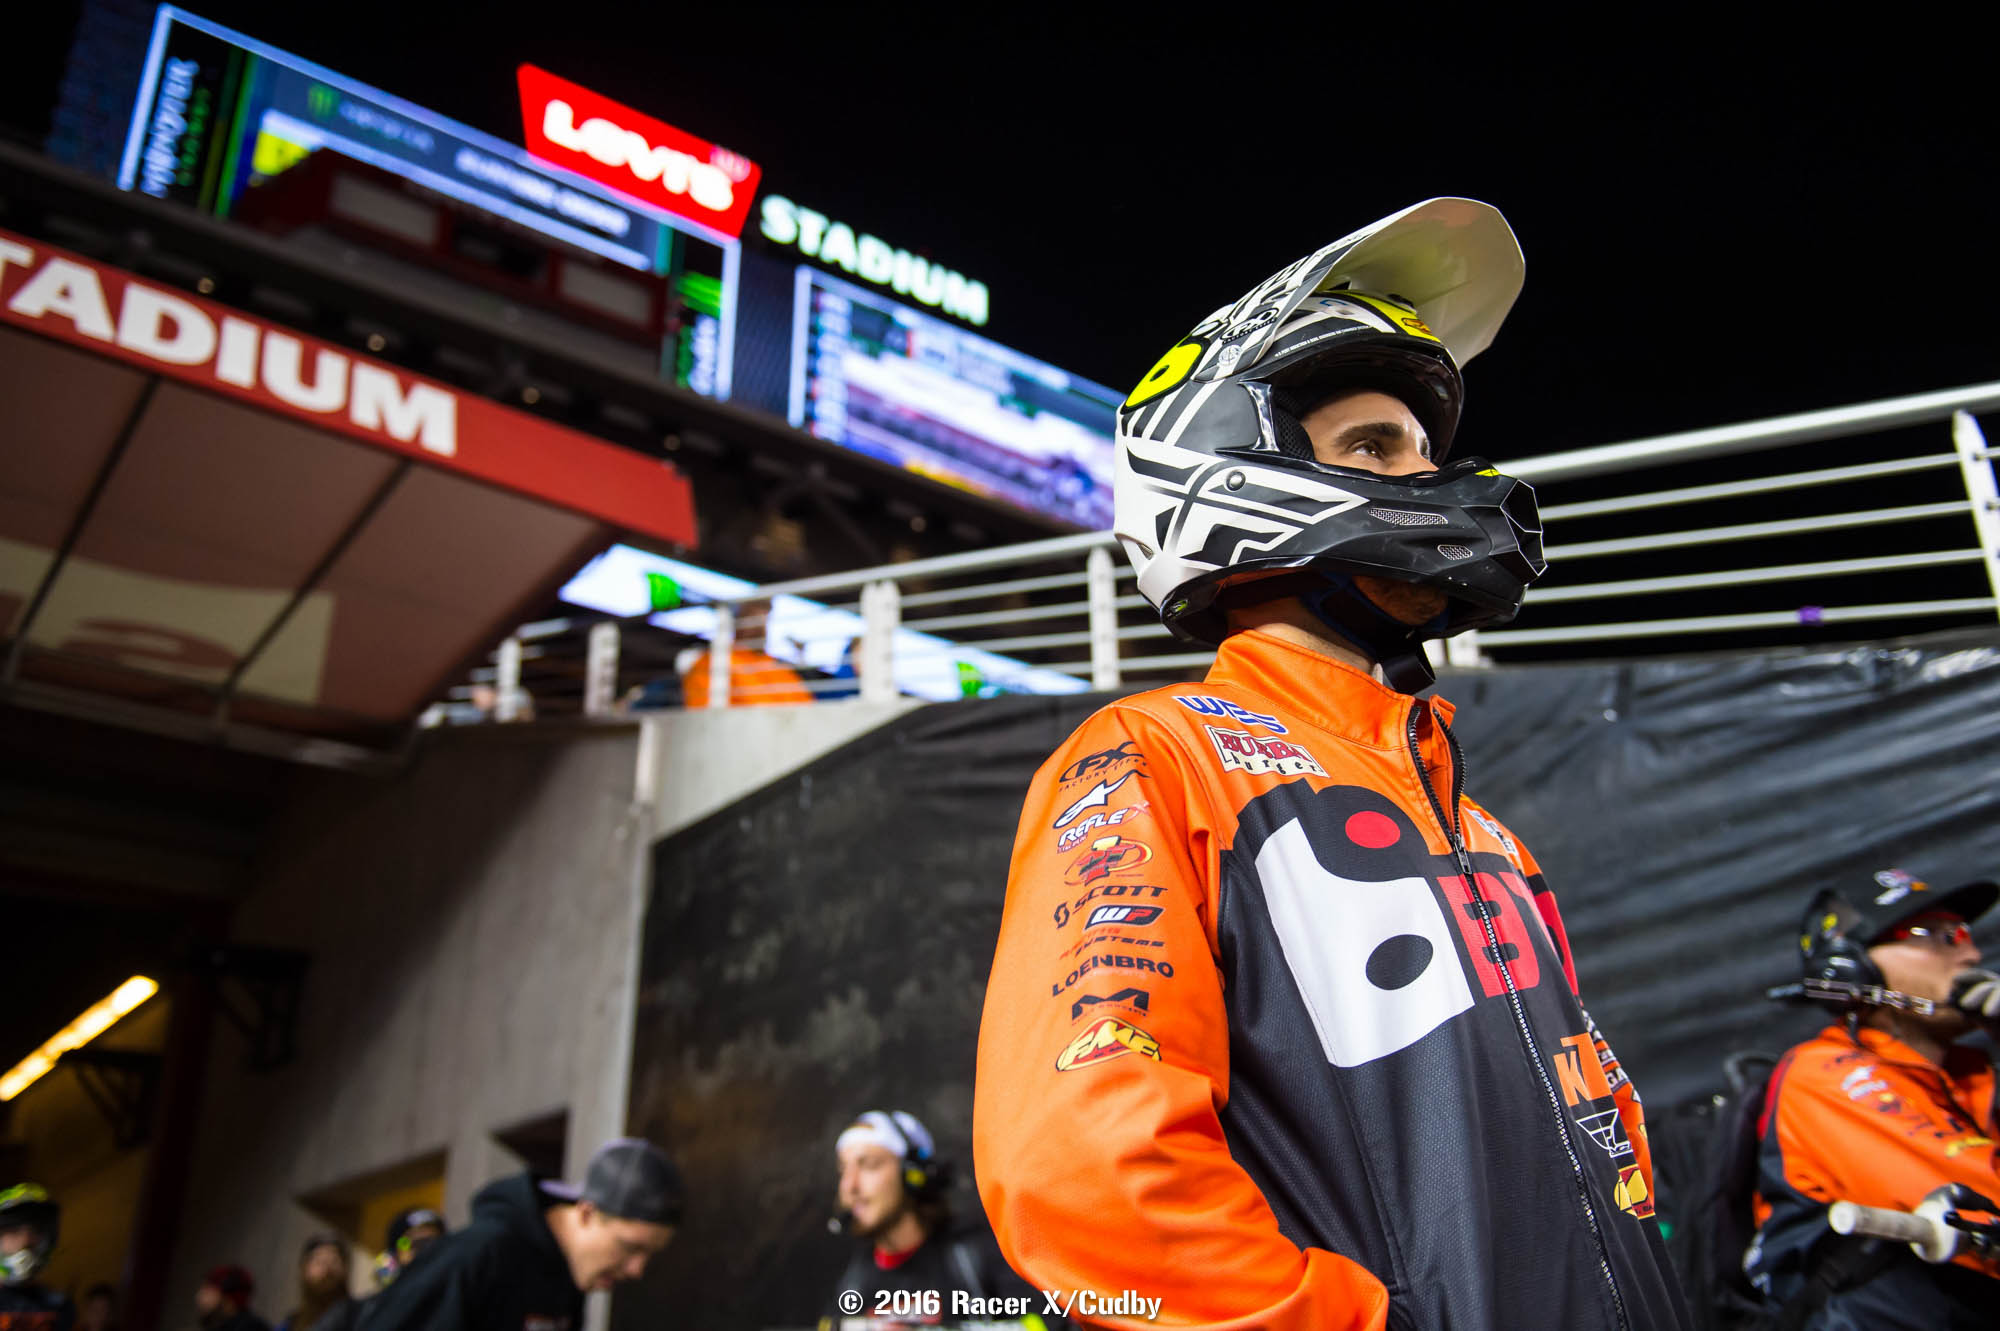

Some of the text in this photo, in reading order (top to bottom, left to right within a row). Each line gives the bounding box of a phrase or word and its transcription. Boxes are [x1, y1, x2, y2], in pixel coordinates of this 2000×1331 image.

[760, 194, 990, 326] STADIUM
[1058, 769, 1106, 792] FACTORY
[1073, 885, 1168, 914] SCOTT
[1090, 907, 1154, 925] WP
[1052, 954, 1174, 997] LOENBRO
